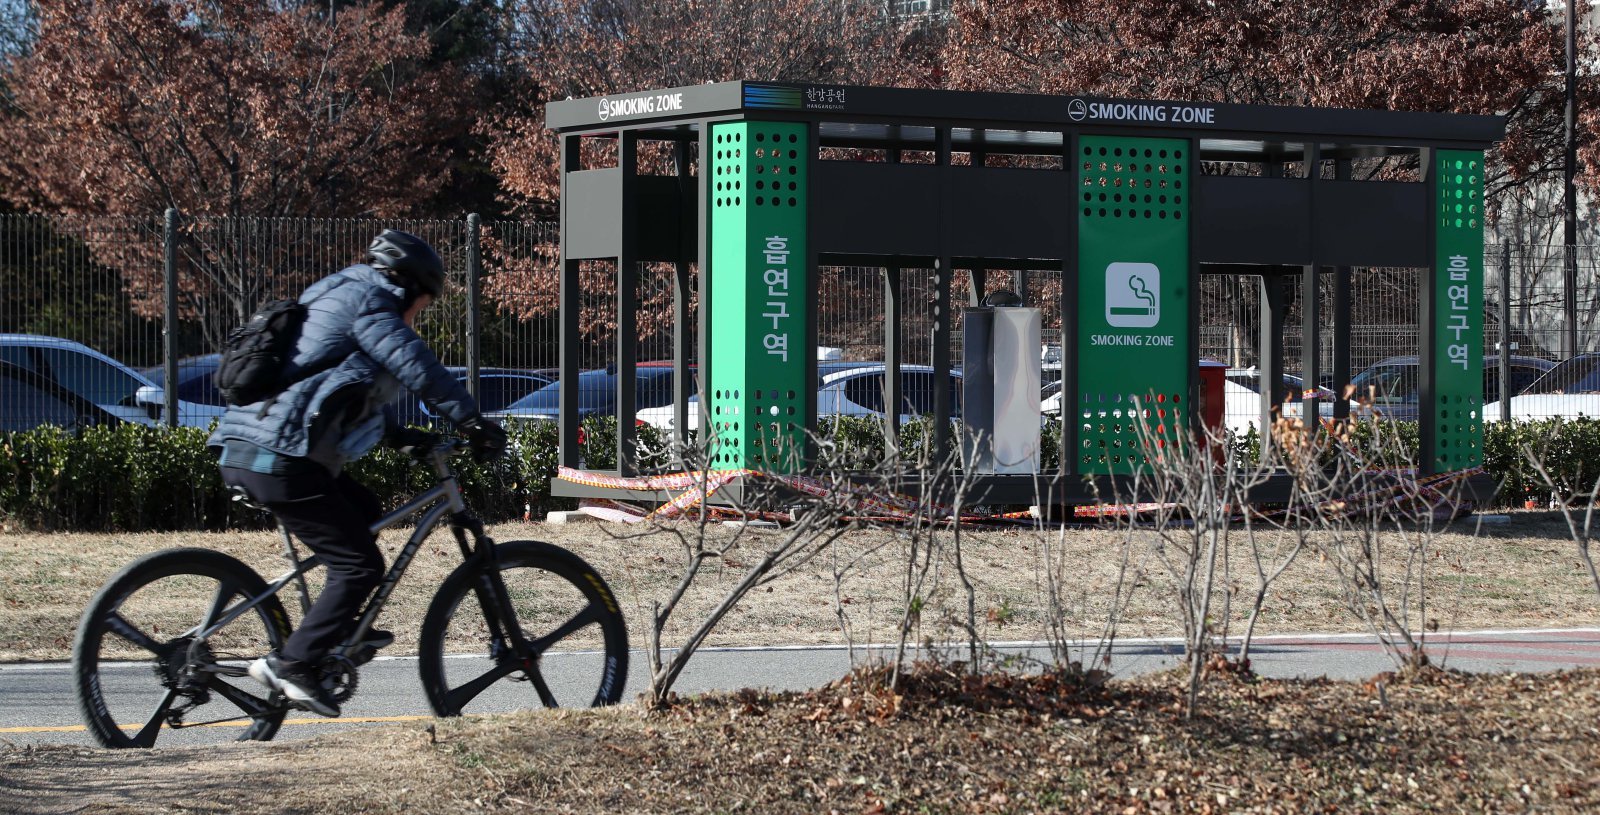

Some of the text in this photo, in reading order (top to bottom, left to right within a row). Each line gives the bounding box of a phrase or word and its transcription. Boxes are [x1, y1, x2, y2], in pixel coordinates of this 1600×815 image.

[610, 93, 683, 117] SMOKING ZONE
[805, 87, 846, 103] 한강공원
[1089, 103, 1215, 124] SMOKING ZONE
[762, 235, 791, 362] 흡연구역
[1446, 254, 1470, 371] 흡연구역
[1090, 334, 1174, 346] SMOKING ZONE
